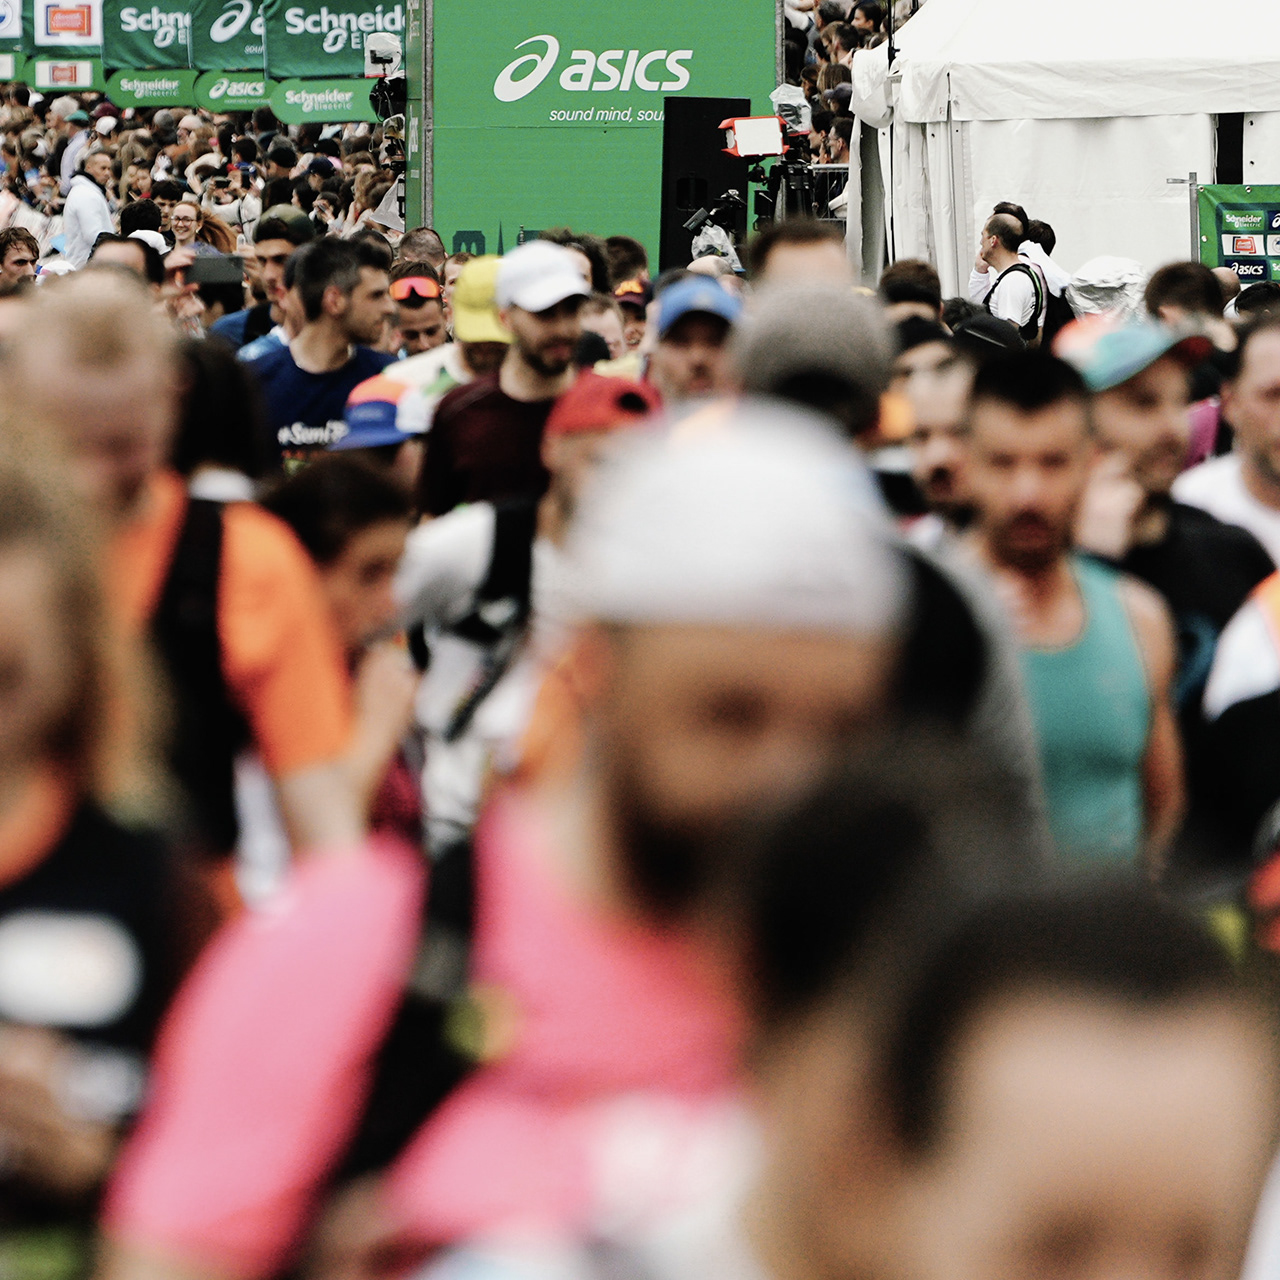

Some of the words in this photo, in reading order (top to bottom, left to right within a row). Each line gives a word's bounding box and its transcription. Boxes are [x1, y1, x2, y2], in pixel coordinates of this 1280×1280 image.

[285, 4, 405, 35] Schneid
[120, 78, 179, 91] Schneider
[285, 89, 353, 104] Schneider
[549, 107, 594, 121] sound
[595, 107, 633, 122] mind,
[1225, 214, 1262, 223] Schneider
